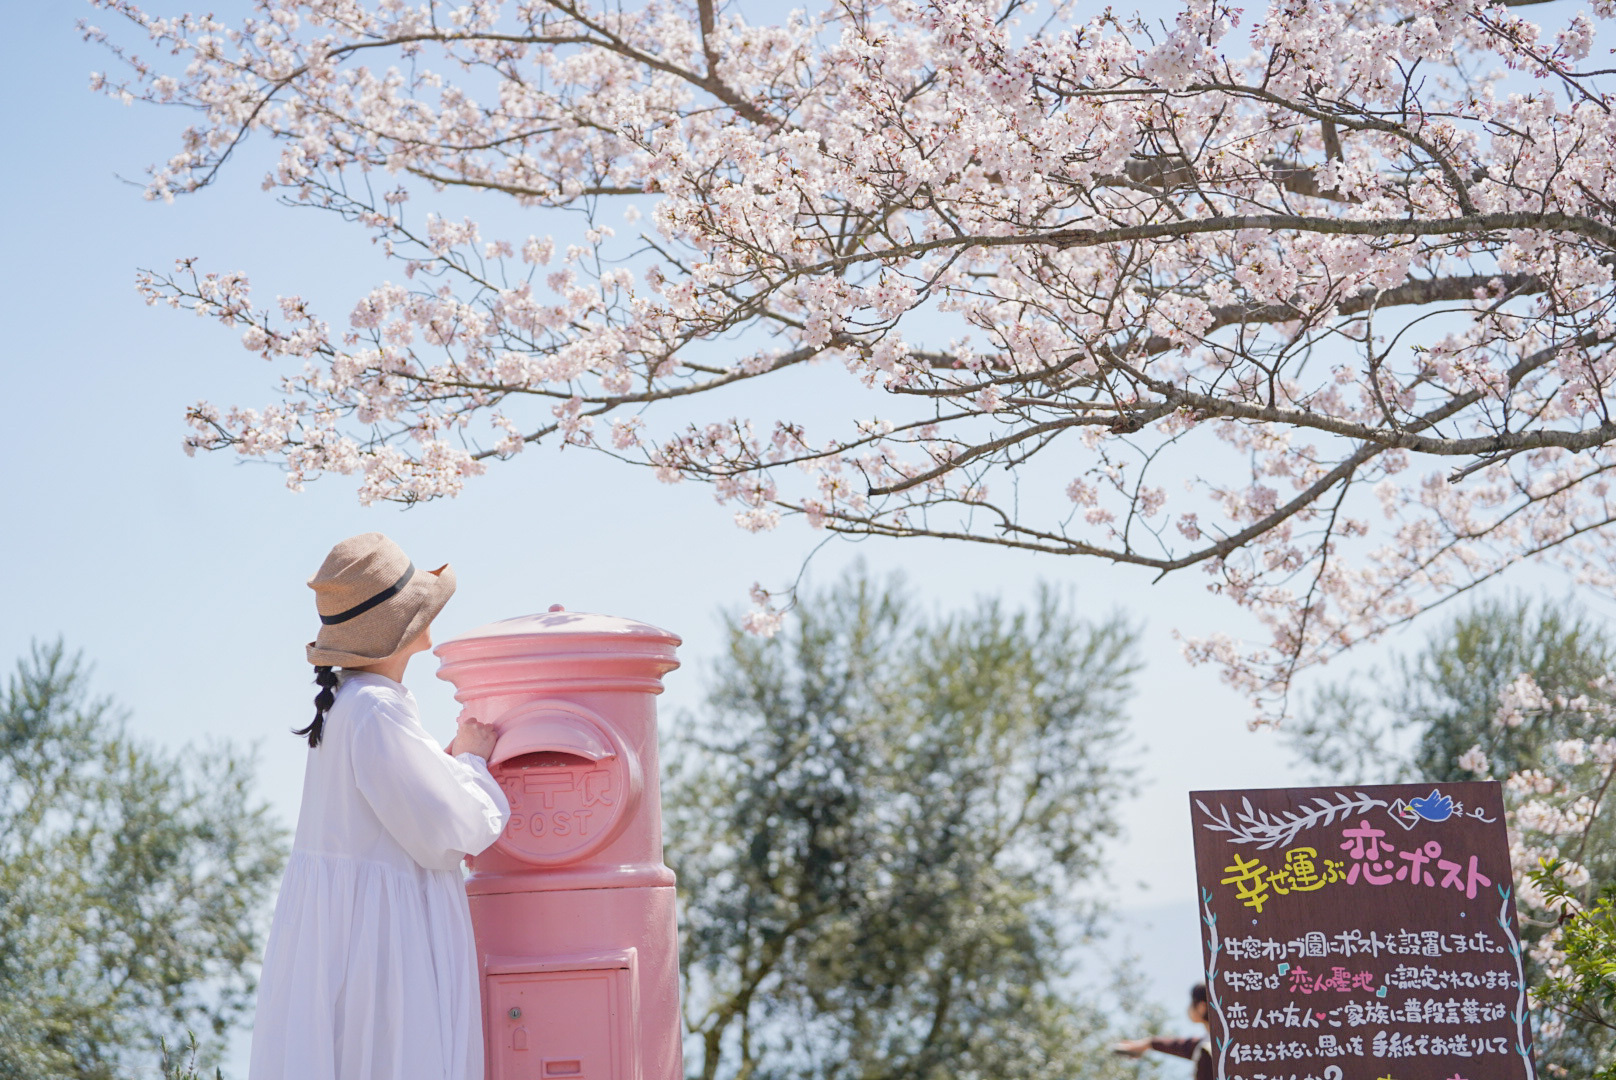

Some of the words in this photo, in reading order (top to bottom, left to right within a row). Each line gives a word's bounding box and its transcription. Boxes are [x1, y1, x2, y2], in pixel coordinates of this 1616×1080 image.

[507, 809, 593, 839] POST
[1224, 928, 1504, 961] 牛窓オリーブ園にポストを設置しました。
